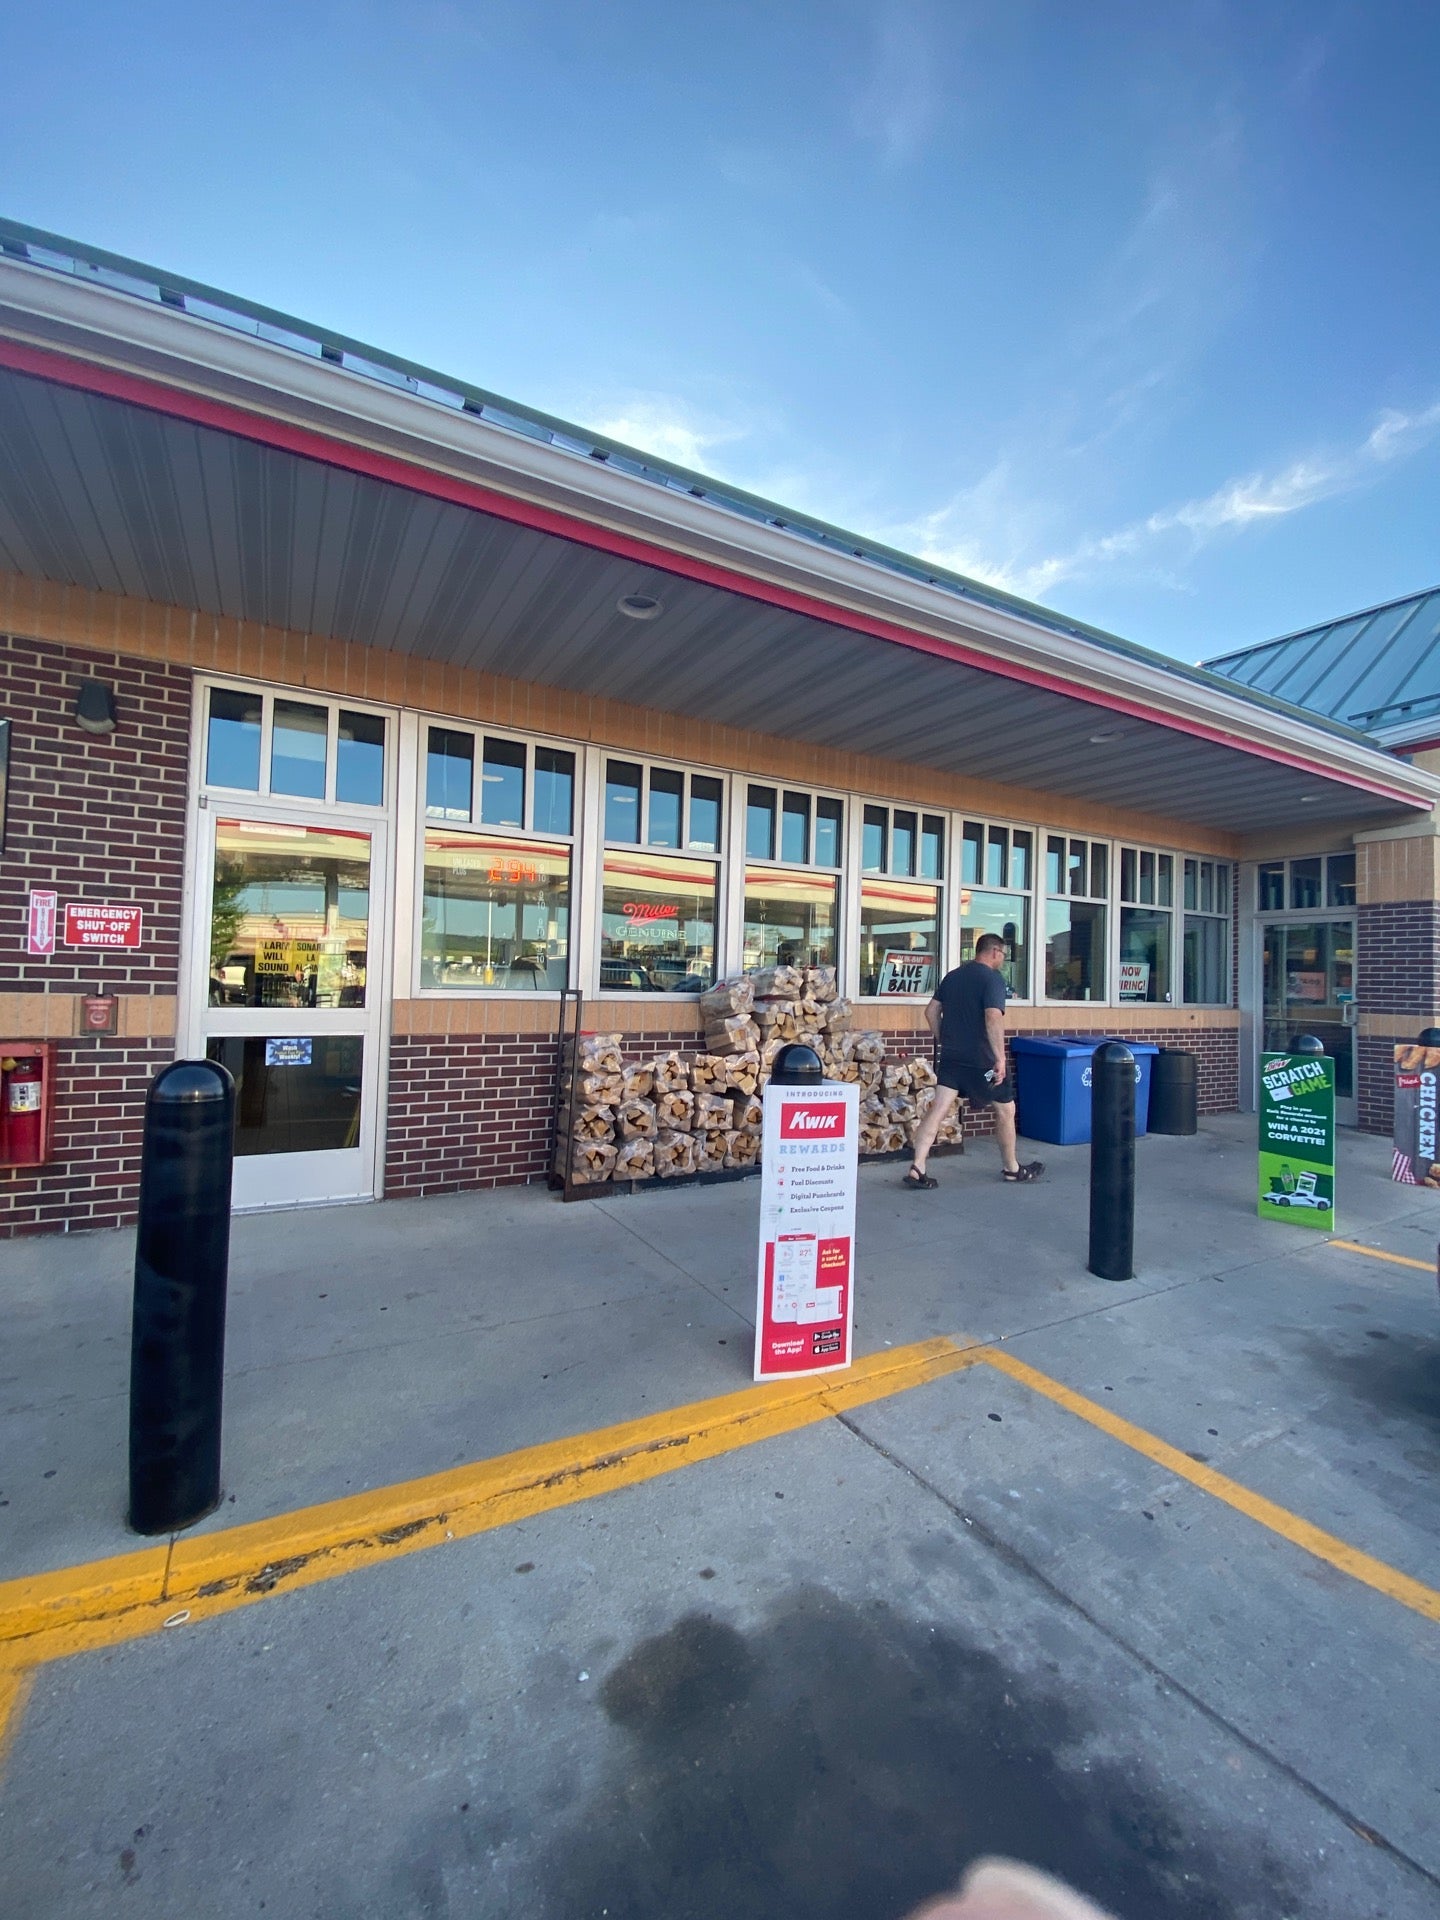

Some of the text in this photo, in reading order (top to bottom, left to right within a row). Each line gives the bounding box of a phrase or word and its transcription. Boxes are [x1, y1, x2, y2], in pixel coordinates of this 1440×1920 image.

[452, 867, 467, 876] PLUS
[35, 899, 52, 907] FIRE
[70, 907, 138, 920] EMERGENCY
[76, 919, 132, 932] SHUT-OFF
[82, 932, 125, 944] SWITCH
[615, 926, 687, 940] GENUINE
[263, 951, 284, 961] WILL
[306, 953, 316, 962] LA
[258, 962, 289, 972] SOUND
[892, 963, 923, 979] LIVE
[1121, 966, 1142, 977] NOW
[888, 978, 922, 993] BAIT
[1119, 979, 1146, 991] IRING!
[1262, 1061, 1325, 1090] SCRATCH
[1290, 1074, 1332, 1096] GAME
[1419, 1072, 1437, 1161] CHICKEN
[1267, 1121, 1326, 1137] WIN A 2021
[1267, 1131, 1326, 1146] CORVETTE!
[779, 1143, 846, 1155] REWARDS
[826, 1163, 846, 1171] Drinks
[790, 1190, 846, 1200] Digital Punchcards
[790, 1204, 845, 1214] Exclusive Coupons
[771, 1339, 805, 1349] Download
[774, 1348, 786, 1356] the
